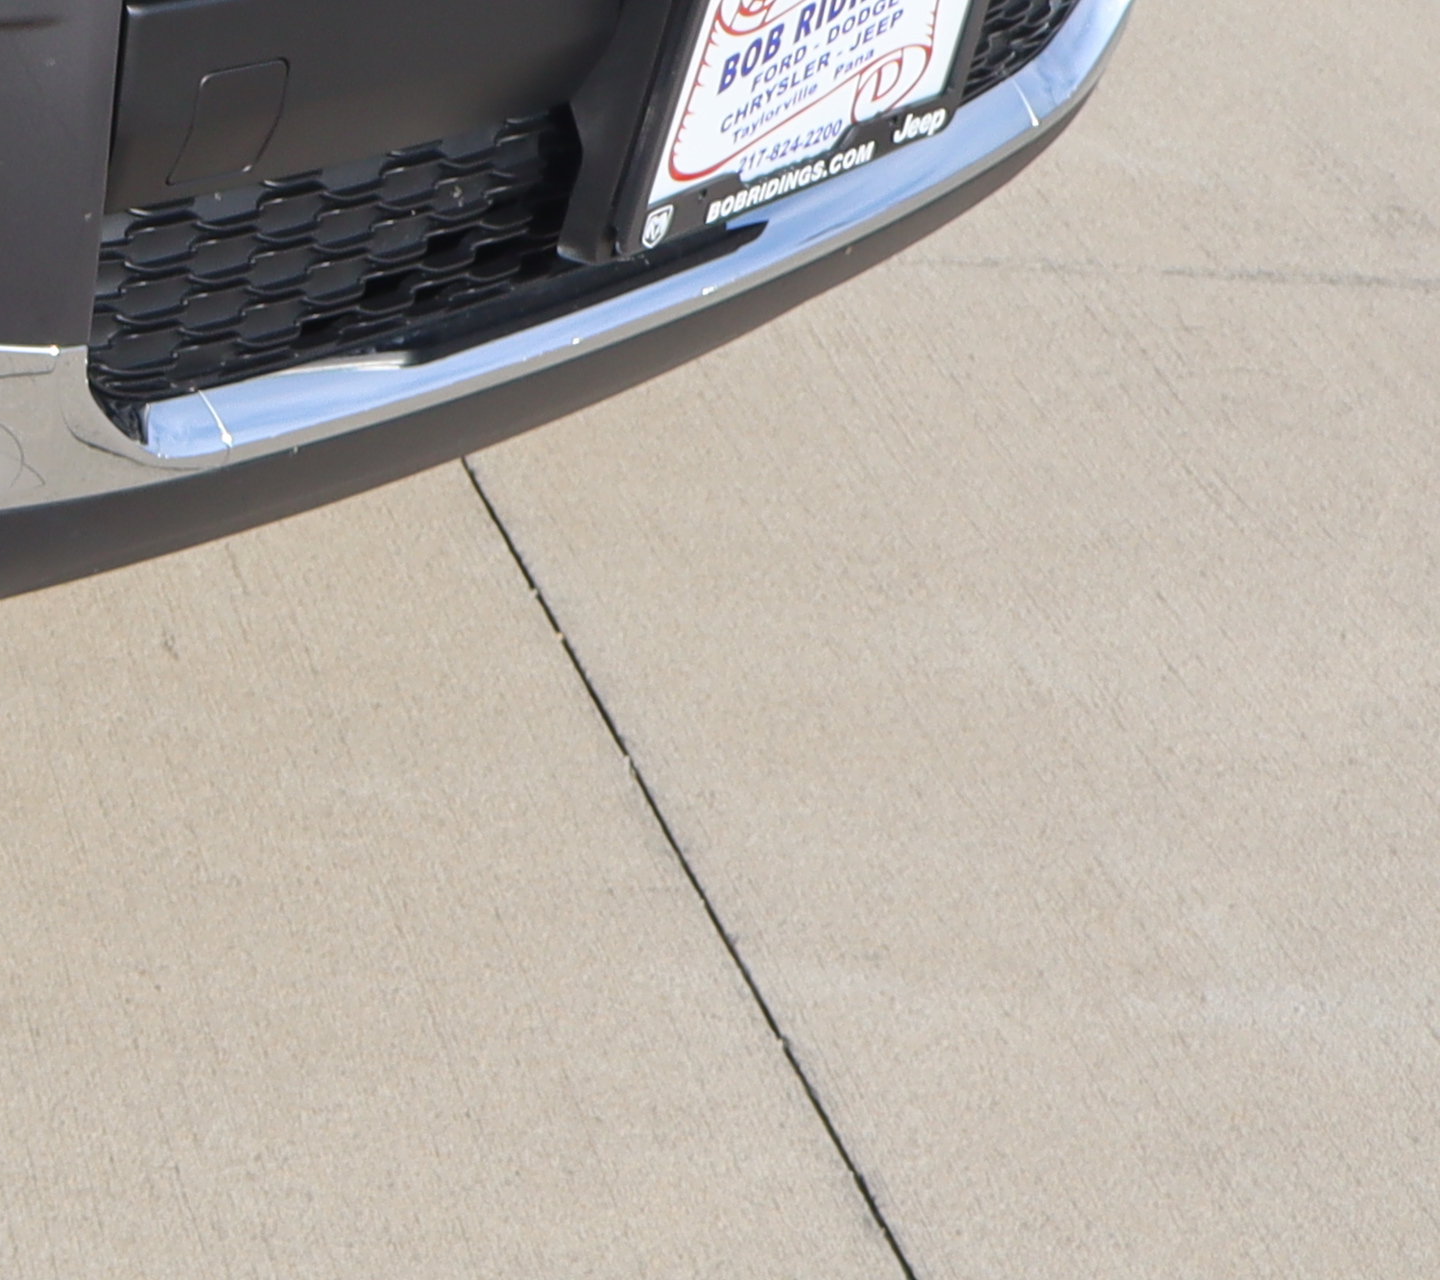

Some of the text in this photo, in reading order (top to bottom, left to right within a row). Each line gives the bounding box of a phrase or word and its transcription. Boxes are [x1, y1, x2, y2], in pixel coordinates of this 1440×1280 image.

[716, 22, 785, 96] BOB
[719, 51, 830, 134] CHRYSLER
[848, 8, 905, 53] JEEP
[751, 45, 809, 93] FORD
[732, 48, 875, 145] Taylorville Pana
[893, 107, 947, 144] Jeep
[705, 141, 875, 225] BOBRIDINGS.COM
[737, 118, 843, 176] 217-824-2200
